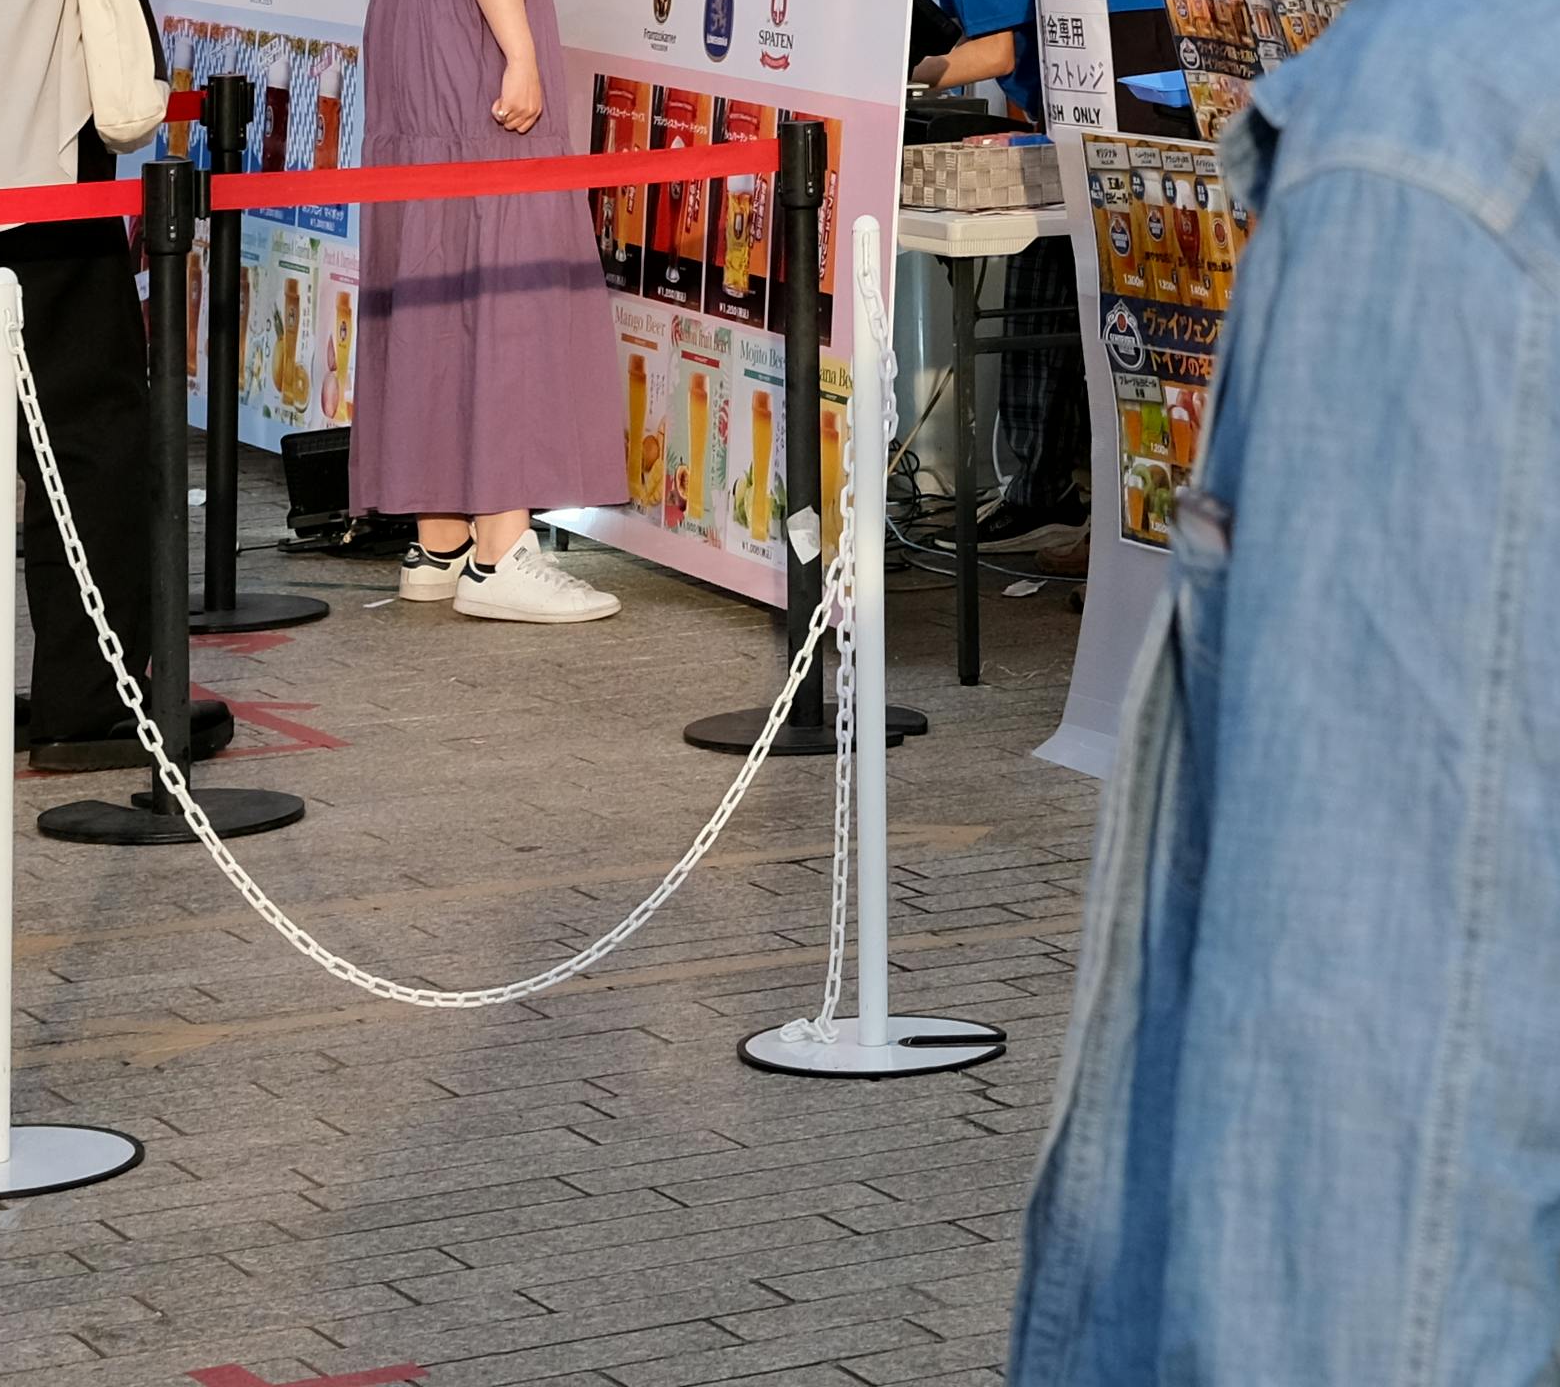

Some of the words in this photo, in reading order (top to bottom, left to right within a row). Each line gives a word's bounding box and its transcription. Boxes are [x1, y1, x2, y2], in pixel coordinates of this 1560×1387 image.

[758, 29, 794, 50] SPATEN
[1044, 59, 1104, 90] ストレジ
[1047, 108, 1065, 123] ASH
[1073, 106, 1101, 125] ONLY
[614, 305, 643, 334] Mango
[645, 313, 667, 337] Beer
[739, 339, 769, 366] Mojito
[768, 346, 787, 370] Bee
